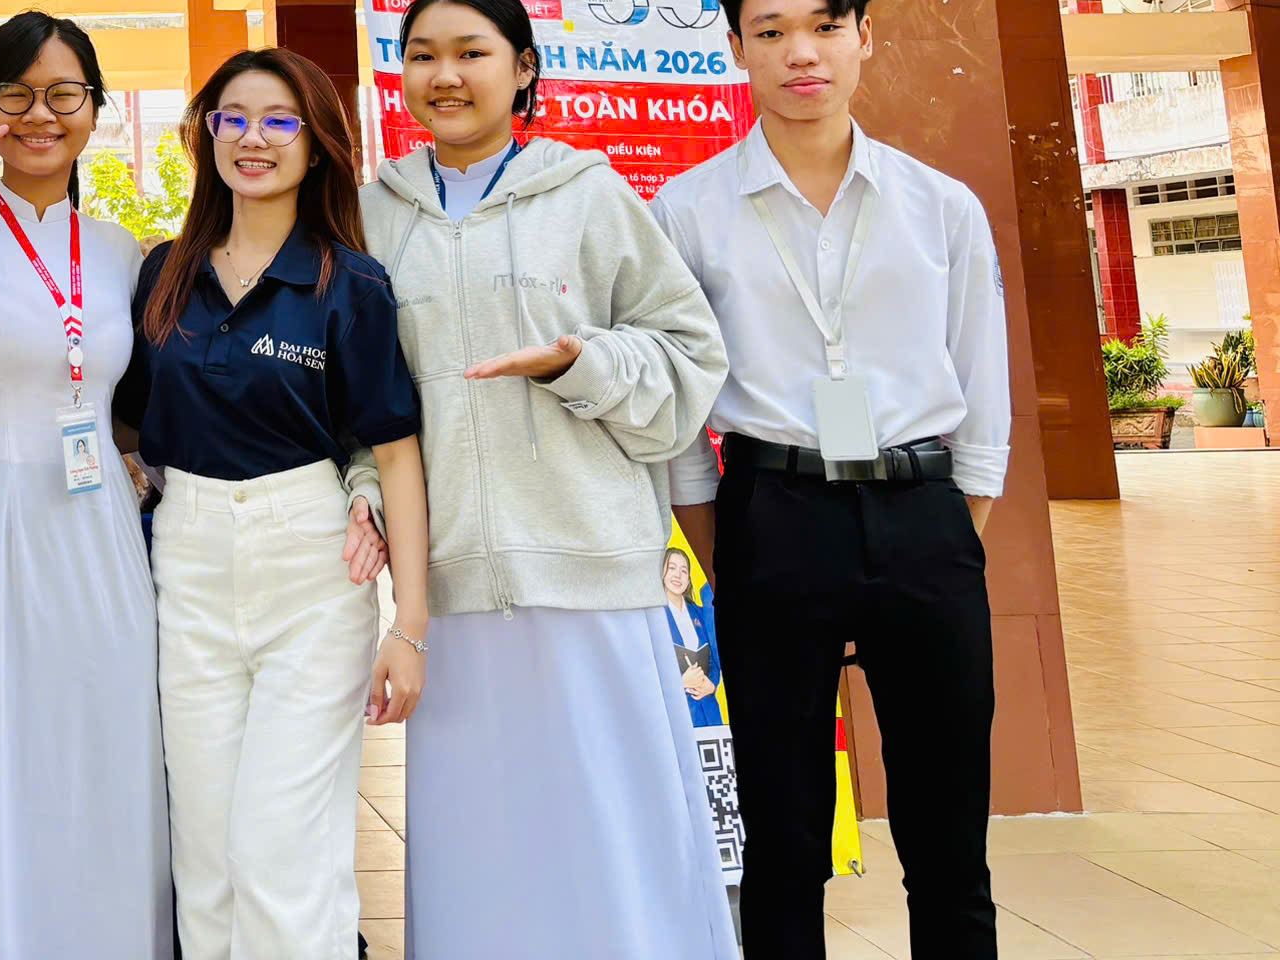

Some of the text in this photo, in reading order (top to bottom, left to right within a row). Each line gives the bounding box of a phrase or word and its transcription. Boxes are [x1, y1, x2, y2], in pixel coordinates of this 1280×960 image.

[576, 41, 647, 72] NĂM
[654, 49, 727, 75] 2026
[555, 91, 638, 121] TOÀN
[647, 94, 733, 122] KHÓA
[635, 145, 661, 157] KIỆN
[277, 350, 325, 371] HOA SEN
